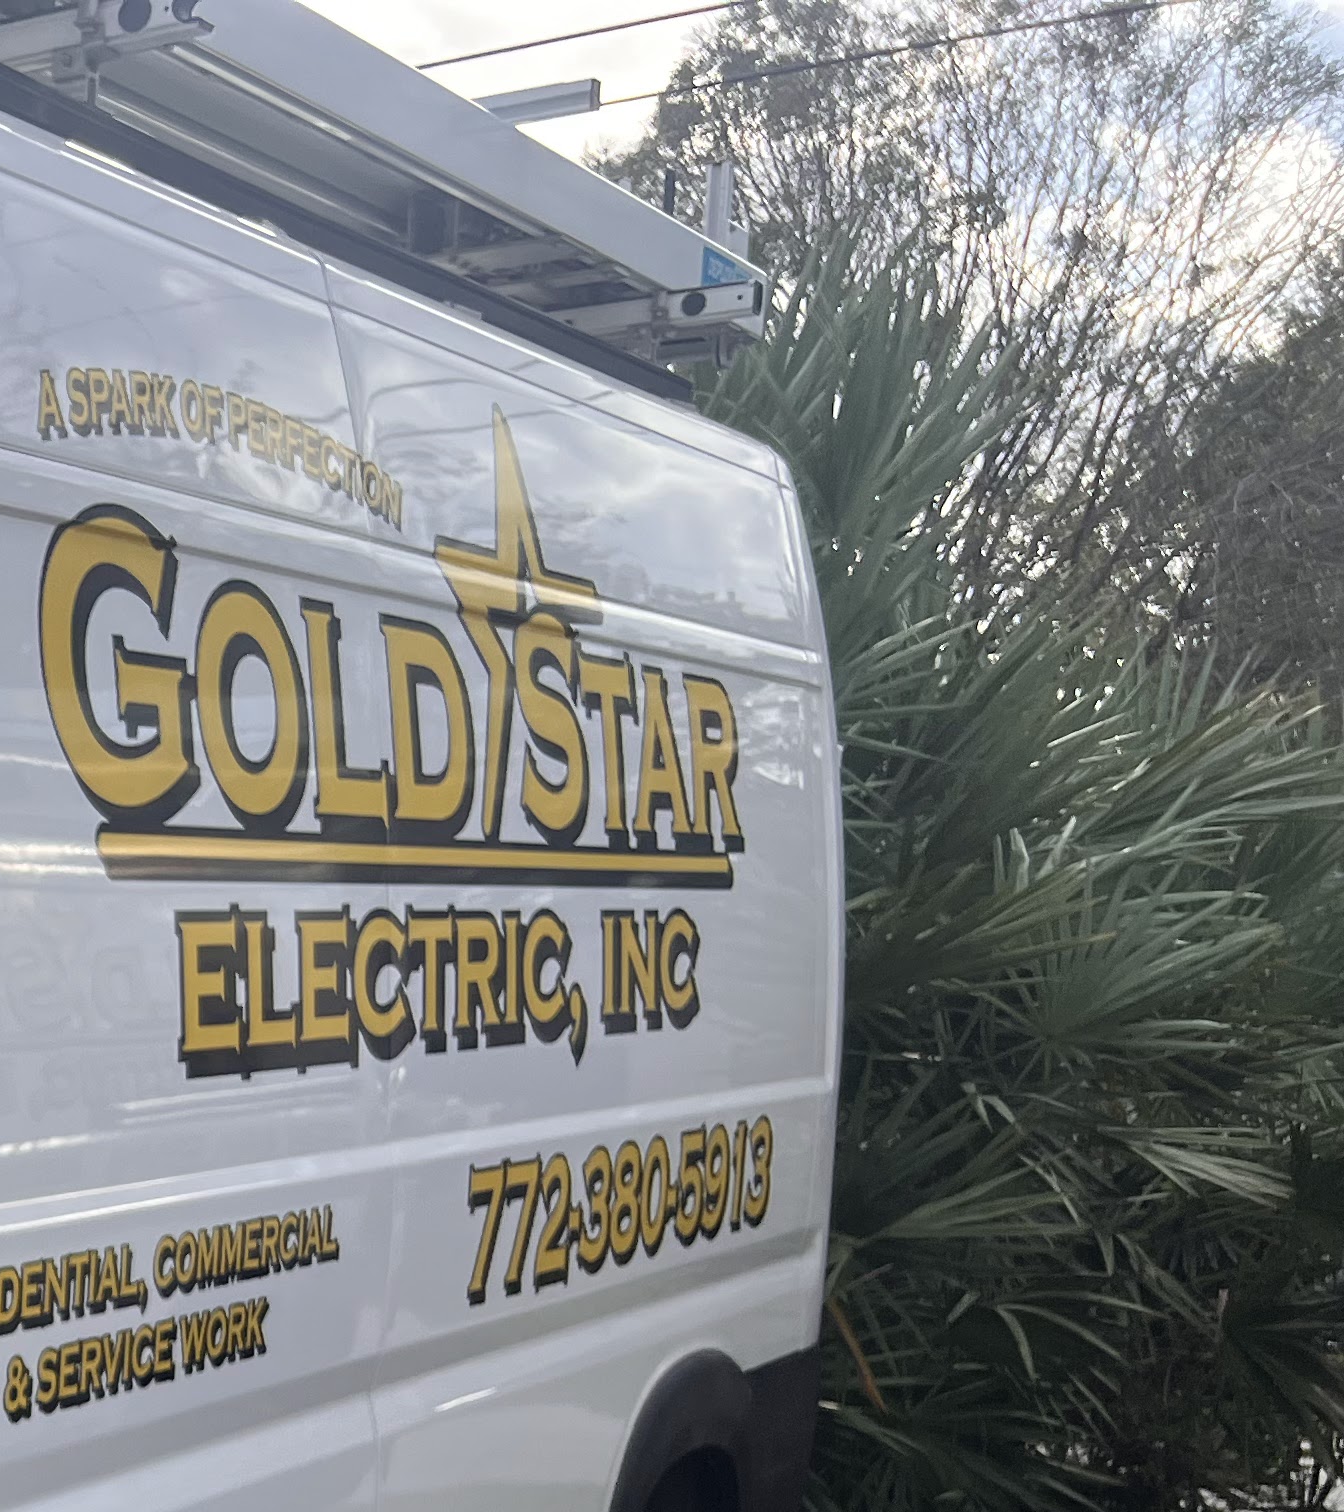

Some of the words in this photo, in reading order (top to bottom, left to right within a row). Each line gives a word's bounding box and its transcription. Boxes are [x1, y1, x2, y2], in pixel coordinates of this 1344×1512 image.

[37, 368, 69, 441] A
[66, 366, 181, 440] SPARK
[179, 378, 227, 445] OF
[225, 390, 404, 534] PERFECTION
[38, 503, 476, 838] GOLD
[509, 608, 746, 854] STAR
[174, 903, 588, 1080] ELECTRIC,
[598, 906, 701, 1035] INC
[153, 1204, 341, 1299] COMMERCIAL
[467, 1114, 774, 1305] 772-380-5913
[2, 1354, 33, 1424] &
[35, 1316, 179, 1414] SERVICE
[178, 1296, 271, 1376] WORK
